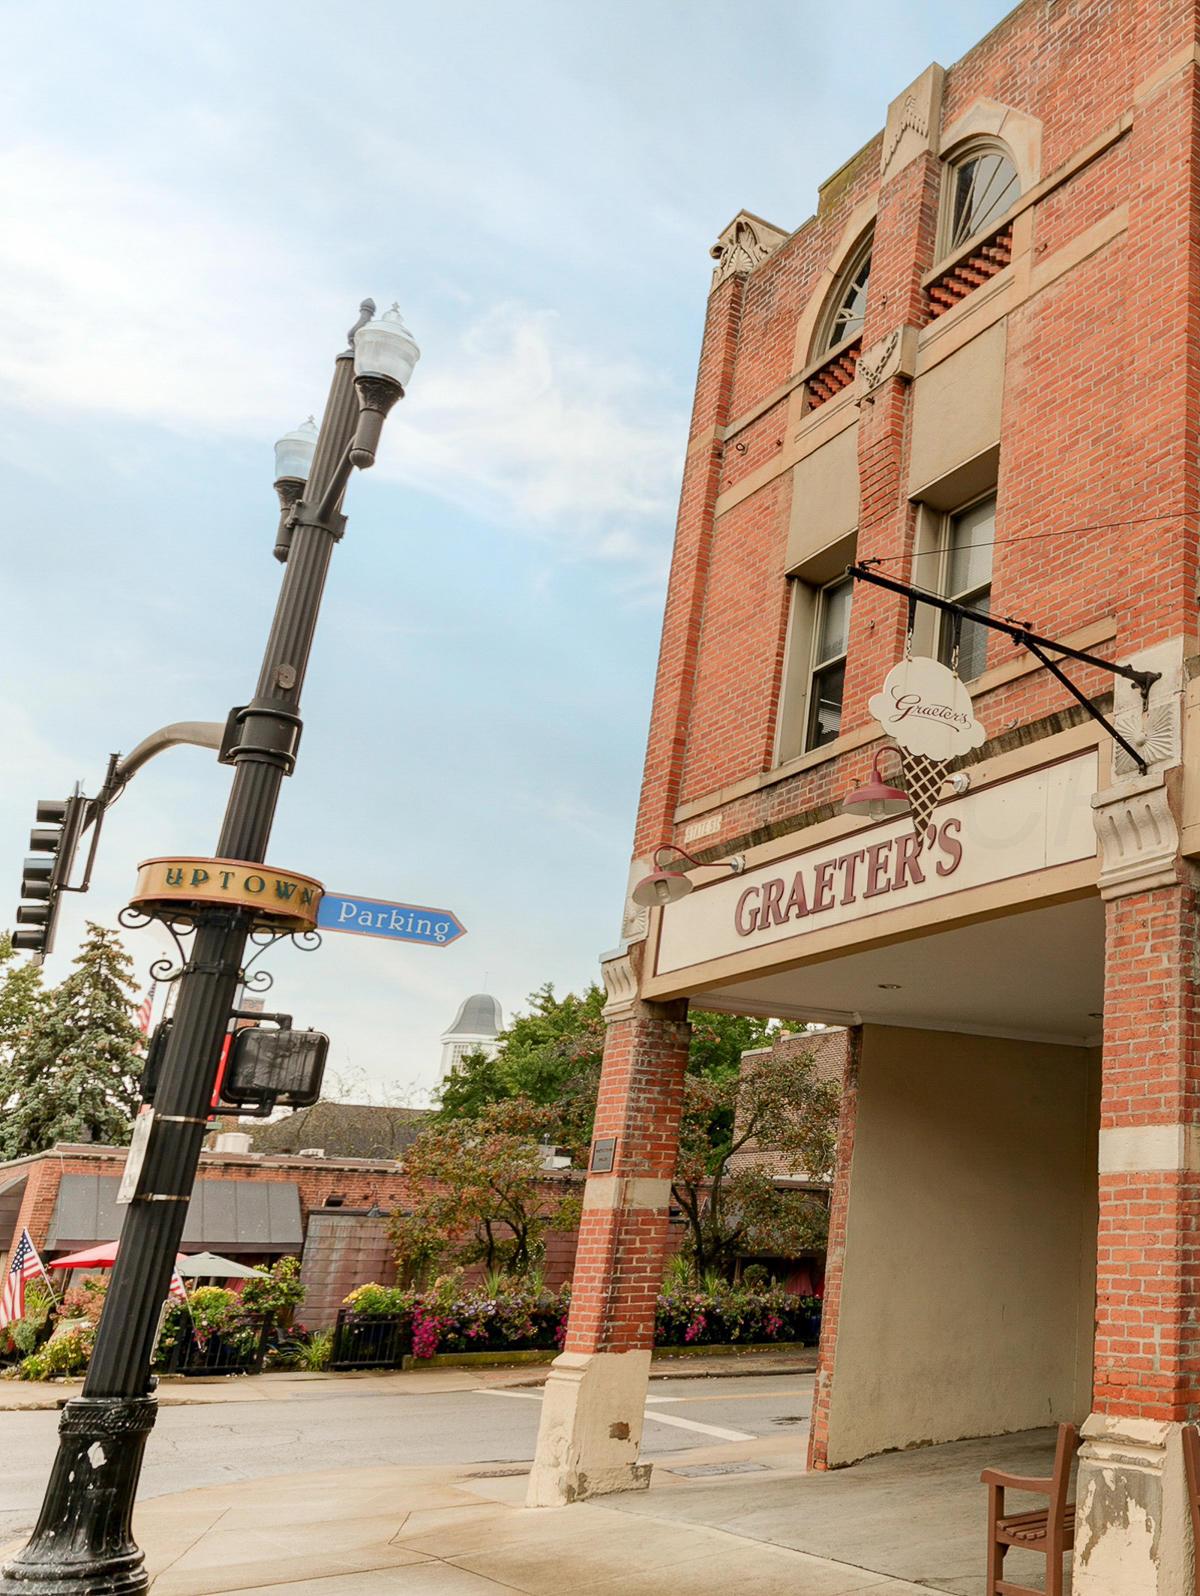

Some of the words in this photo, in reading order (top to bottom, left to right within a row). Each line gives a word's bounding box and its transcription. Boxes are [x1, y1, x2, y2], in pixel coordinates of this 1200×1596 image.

[889, 685, 972, 732] Graeter's
[165, 867, 315, 905] UPTOWN
[734, 817, 963, 937] GRAETER'S
[337, 901, 450, 943] Parking
